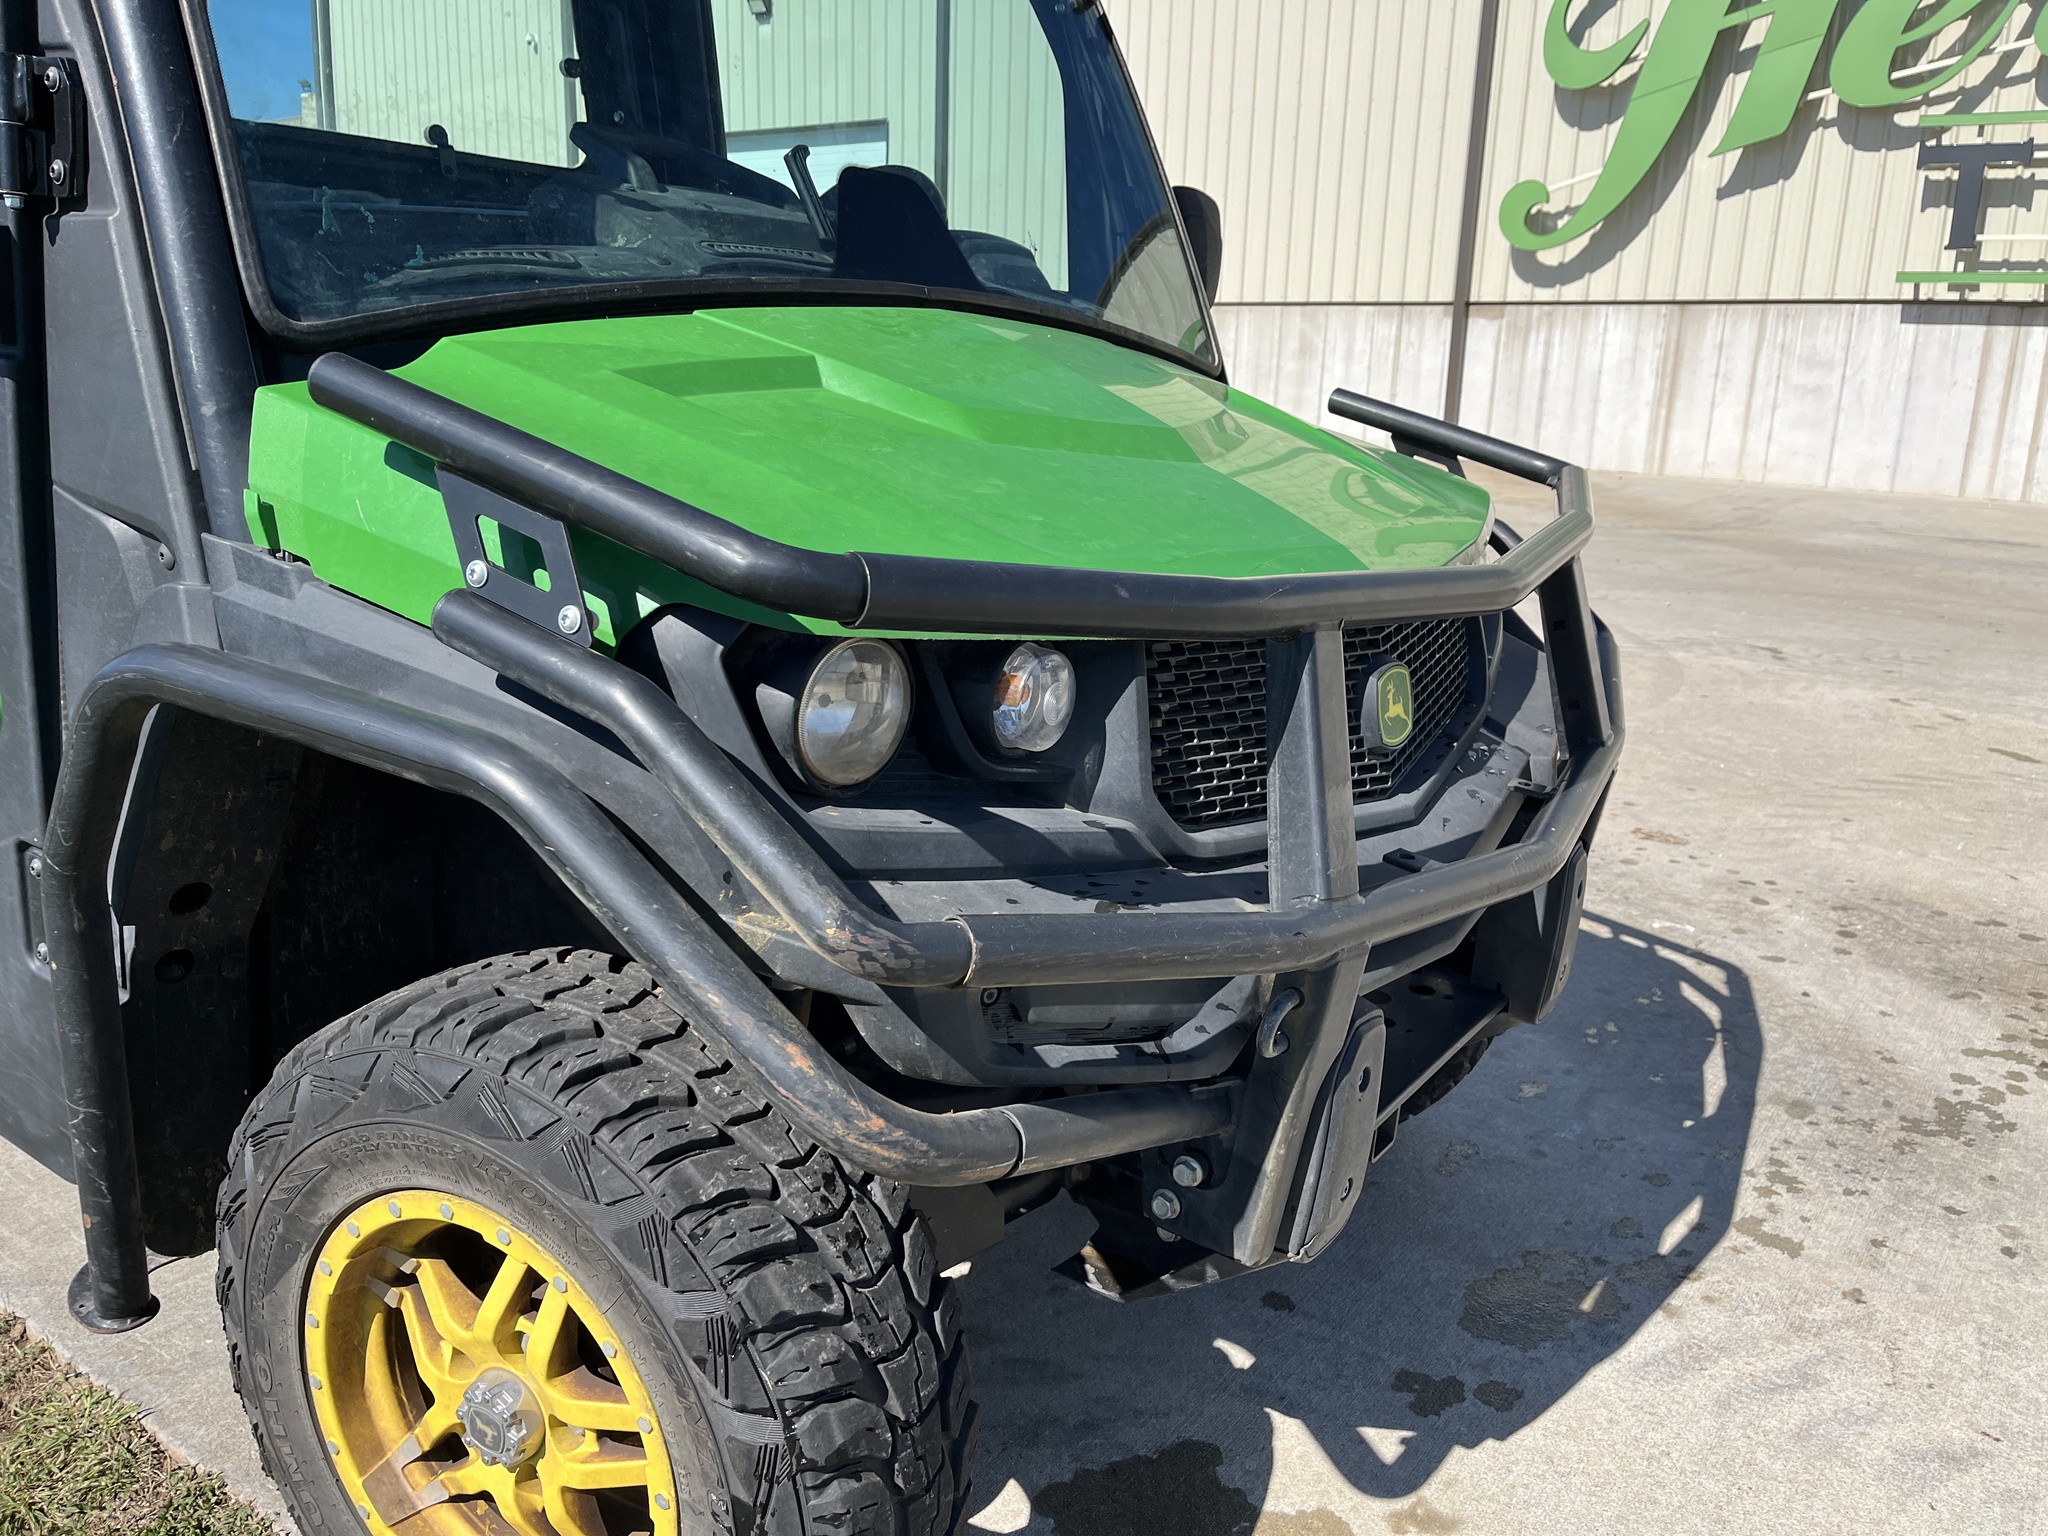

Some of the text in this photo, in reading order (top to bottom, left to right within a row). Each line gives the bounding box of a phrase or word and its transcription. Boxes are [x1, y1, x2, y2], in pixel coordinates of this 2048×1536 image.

[328, 1132, 371, 1153] LOAD
[375, 1129, 440, 1148] RANGE
[339, 1140, 459, 1162] 6 PLY RATING
[473, 1153, 624, 1284] ROAD
[626, 1340, 648, 1368] DOT
[254, 1353, 330, 1536] UMHO
